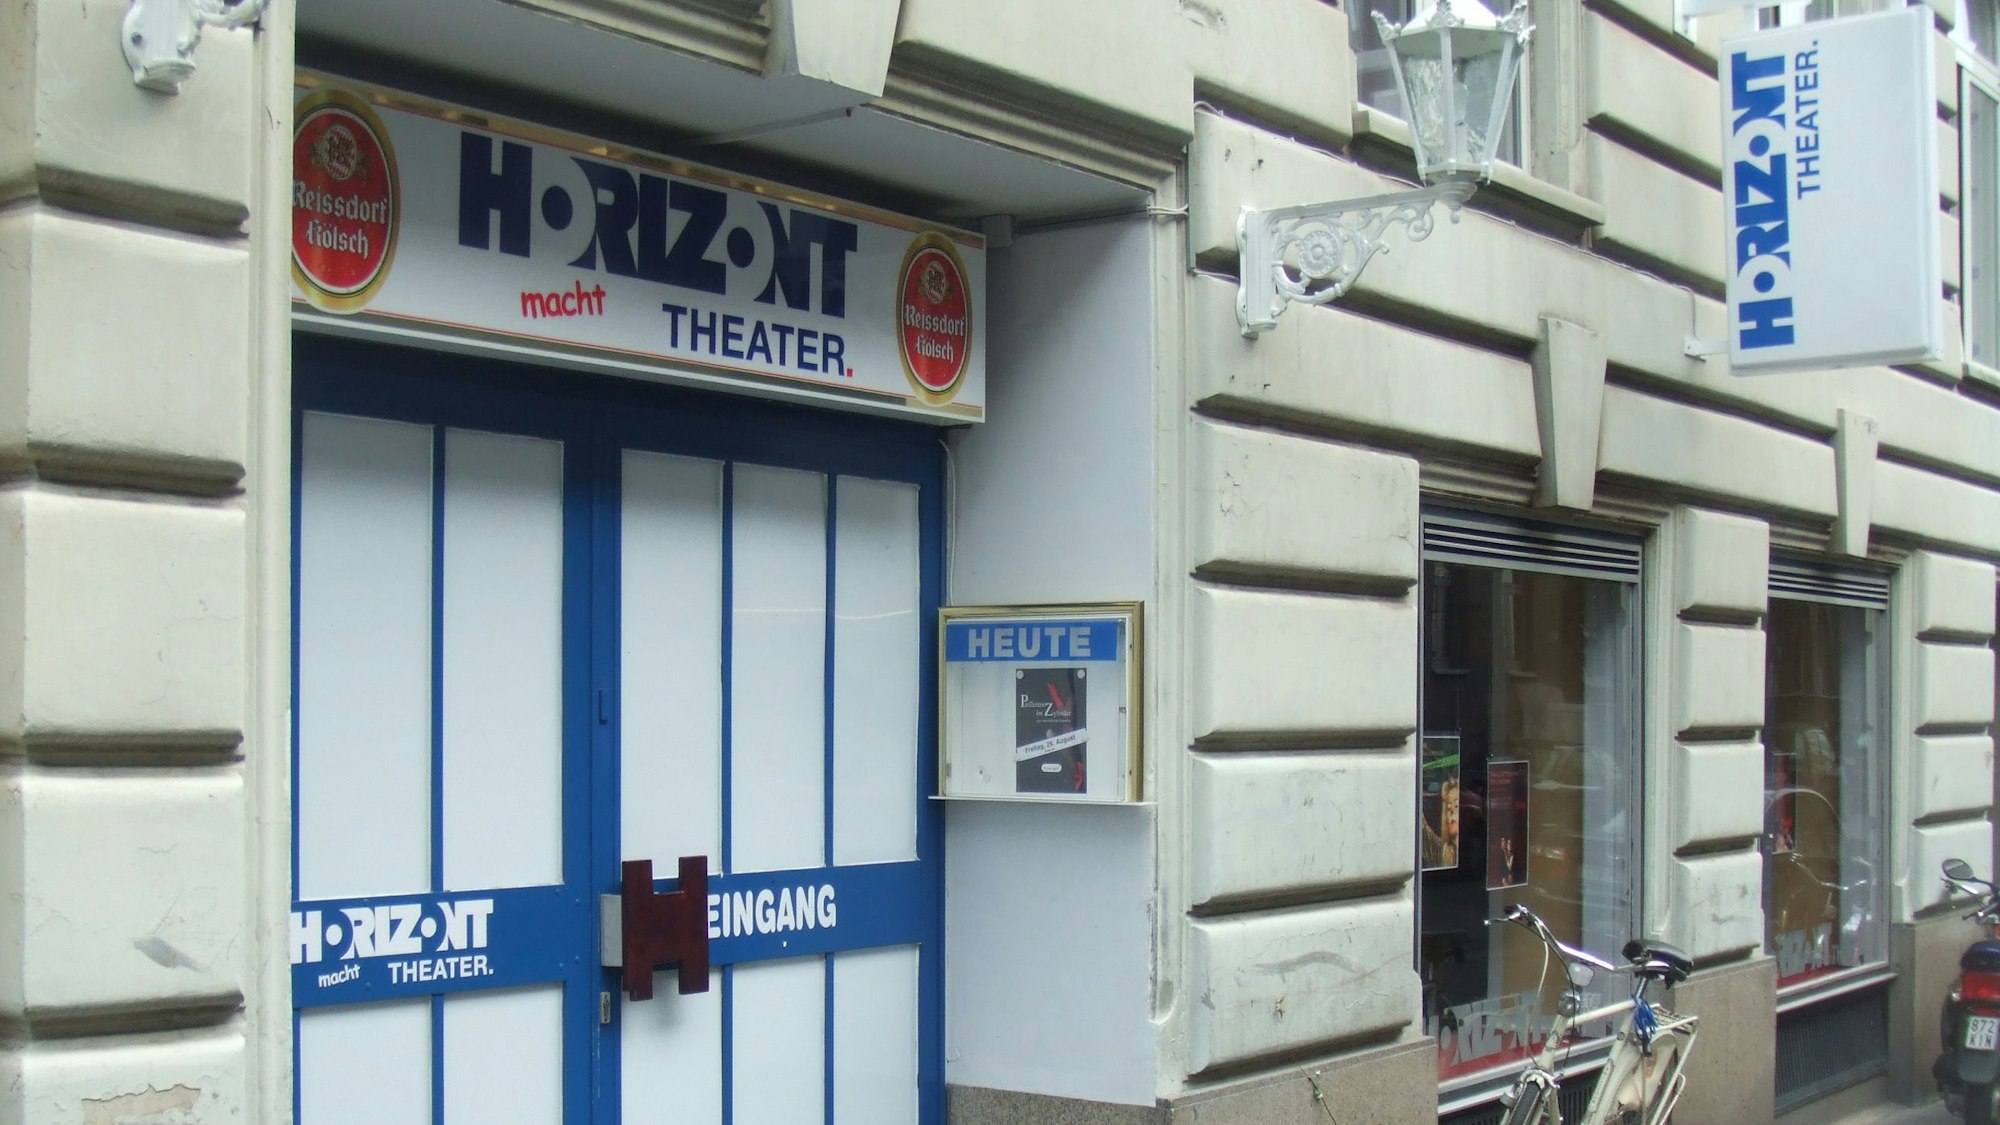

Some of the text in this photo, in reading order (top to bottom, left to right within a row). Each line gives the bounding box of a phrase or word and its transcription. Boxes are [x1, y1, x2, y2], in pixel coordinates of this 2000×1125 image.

[1795, 39, 1820, 200] THEATER.
[293, 180, 388, 224] Reissdorf
[1731, 51, 1795, 350] HORIZONT
[306, 218, 369, 260] Kölsch
[459, 132, 858, 319] HORIZONT
[520, 281, 606, 319] macht
[904, 303, 965, 337] Reissdorf
[662, 303, 853, 378] THEATER.
[916, 334, 954, 364] Kölsch
[968, 626, 1091, 659] HEUTE
[290, 899, 494, 964] HORIZONT
[707, 884, 837, 939] EINGANG
[318, 963, 361, 988] macht
[388, 956, 494, 985] THEATER.
